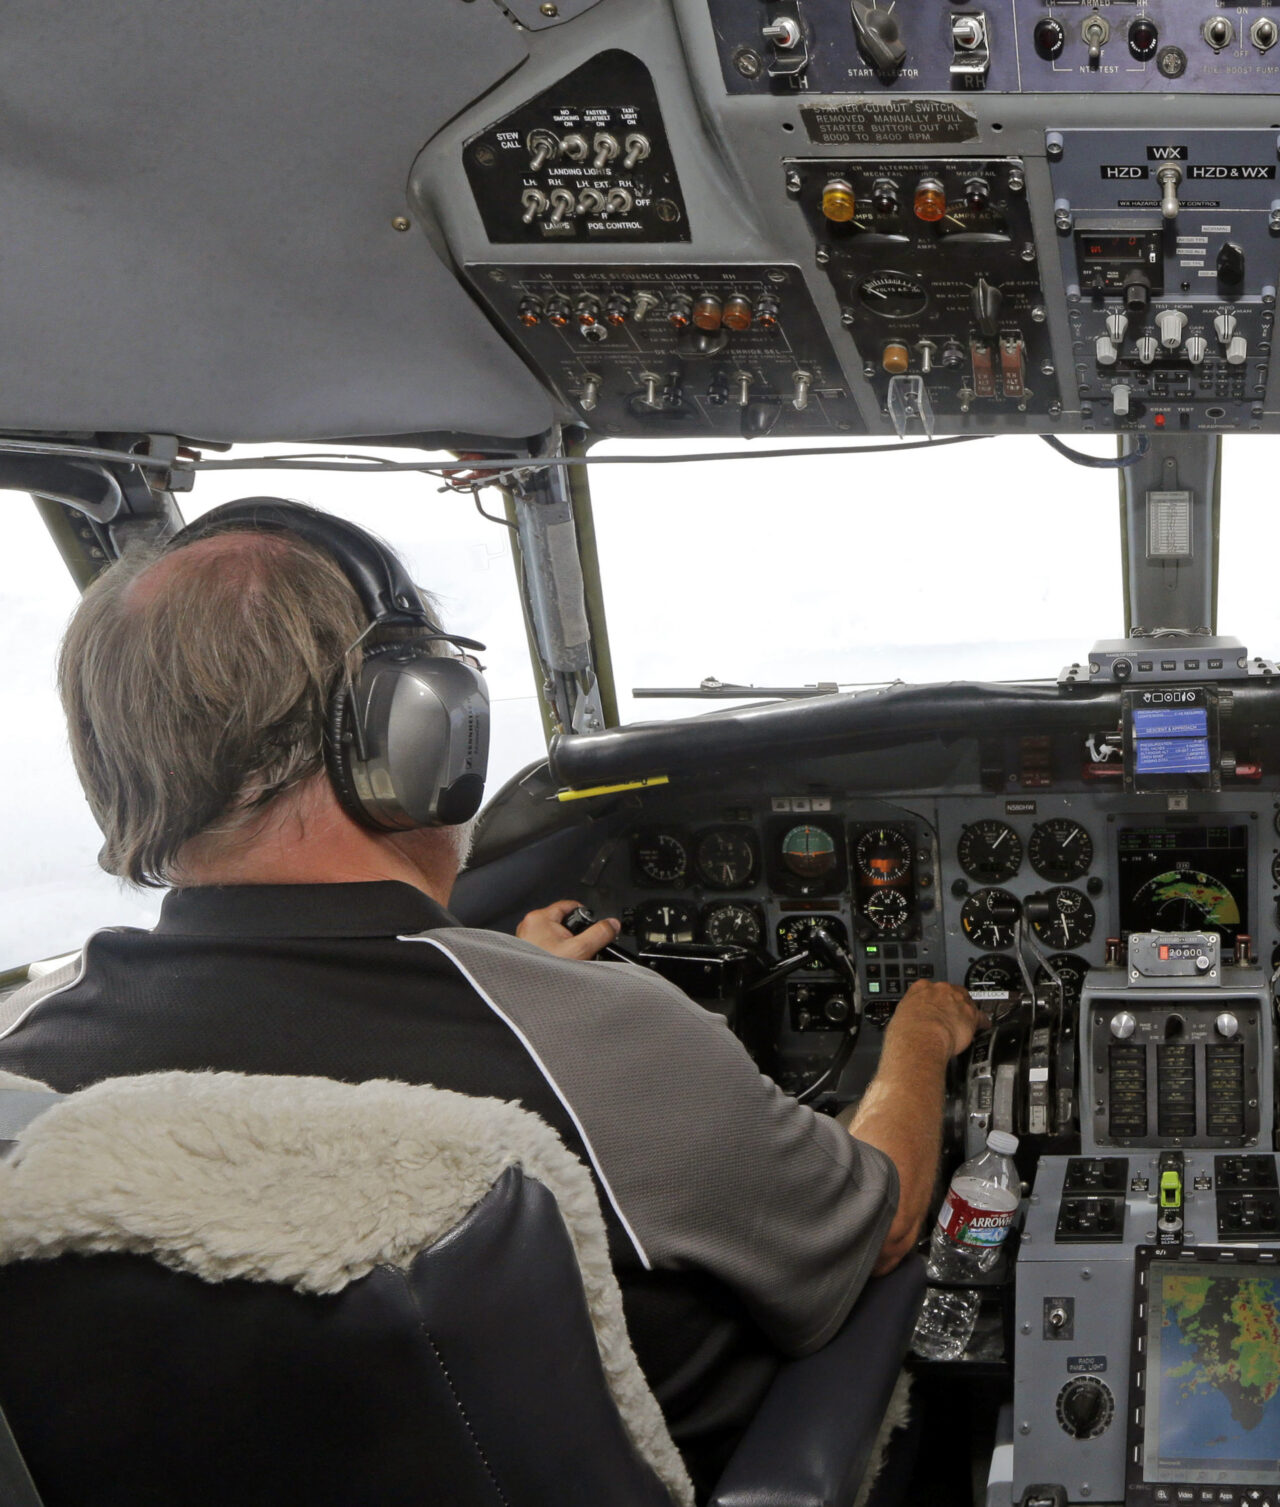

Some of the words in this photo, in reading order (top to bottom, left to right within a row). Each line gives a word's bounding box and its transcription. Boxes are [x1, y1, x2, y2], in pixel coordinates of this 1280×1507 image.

[790, 76, 808, 89] LH
[964, 74, 986, 89] RH
[865, 104, 908, 113] CUTOUT
[915, 103, 955, 113] SWITCH
[816, 115, 866, 123] REMOVED
[874, 115, 929, 123] MANUALLY
[870, 124, 913, 132] BUTTON
[496, 132, 519, 141] STEW
[823, 133, 850, 141] 8000
[501, 140, 521, 149] CALL
[1153, 148, 1181, 158] WX
[1106, 167, 1142, 178] HZD
[1193, 167, 1228, 178] HZD
[1230, 167, 1239, 177] &
[1243, 167, 1268, 177] WX
